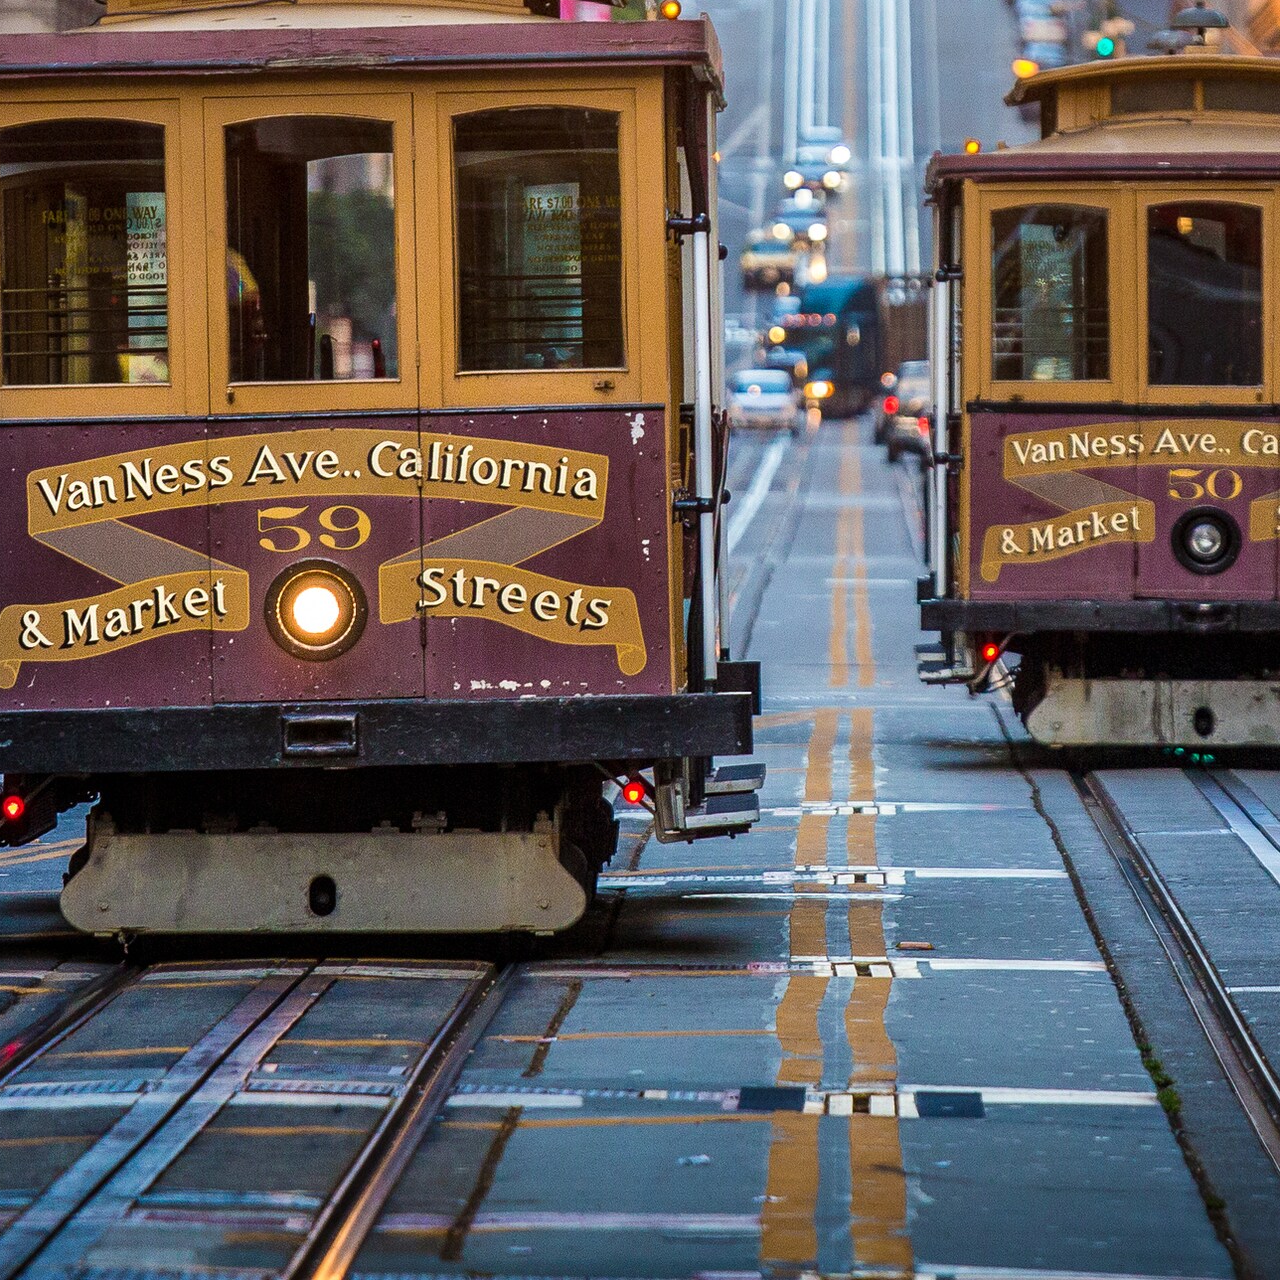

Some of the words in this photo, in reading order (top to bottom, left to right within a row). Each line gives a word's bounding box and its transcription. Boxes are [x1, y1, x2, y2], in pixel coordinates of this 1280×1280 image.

[132, 206, 157, 220] WAY
[1011, 438, 1065, 466] Van
[1069, 431, 1145, 459] Ness
[38, 473, 118, 515] Van
[120, 455, 234, 498] Ness
[369, 439, 599, 500] California
[1168, 469, 1243, 500] 50
[257, 505, 372, 553] 59
[1001, 528, 1023, 554] &
[1030, 506, 1142, 552] Market
[20, 609, 54, 649] &
[65, 579, 228, 646] Market
[418, 566, 612, 628] Streets
